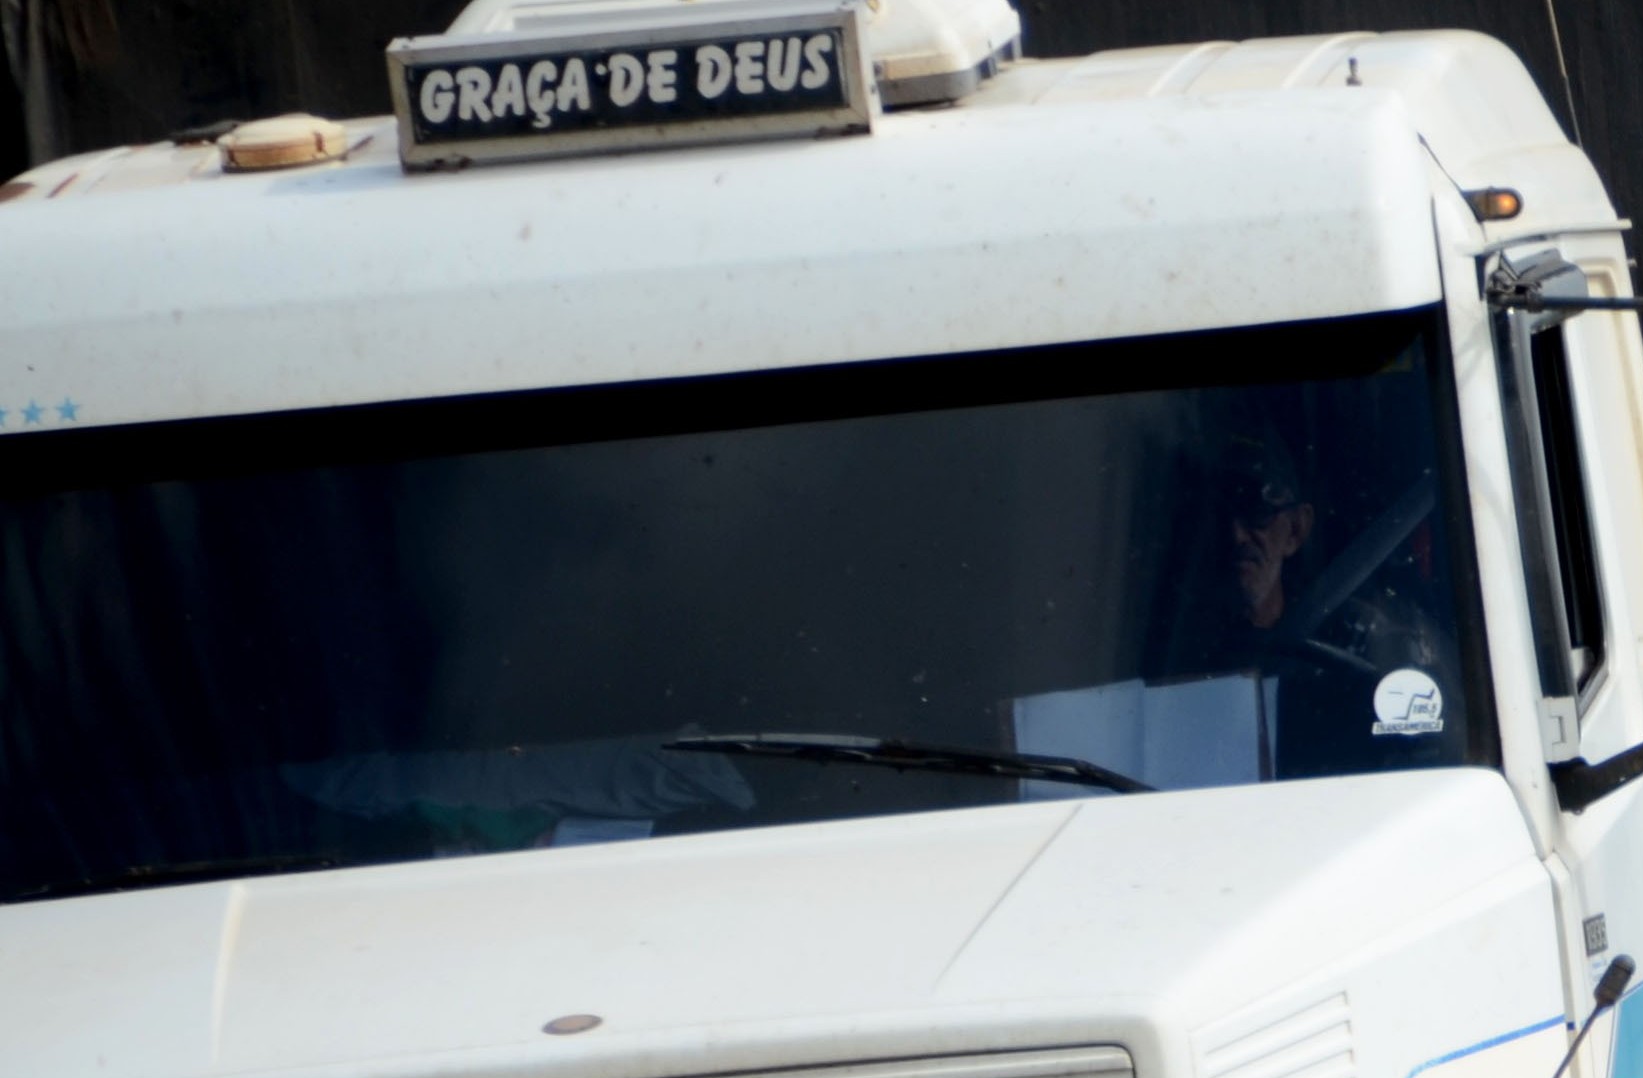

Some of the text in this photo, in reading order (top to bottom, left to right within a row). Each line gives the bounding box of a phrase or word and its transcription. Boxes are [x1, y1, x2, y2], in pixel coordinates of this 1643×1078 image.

[420, 33, 833, 129] GRAÇA DE DEUS
